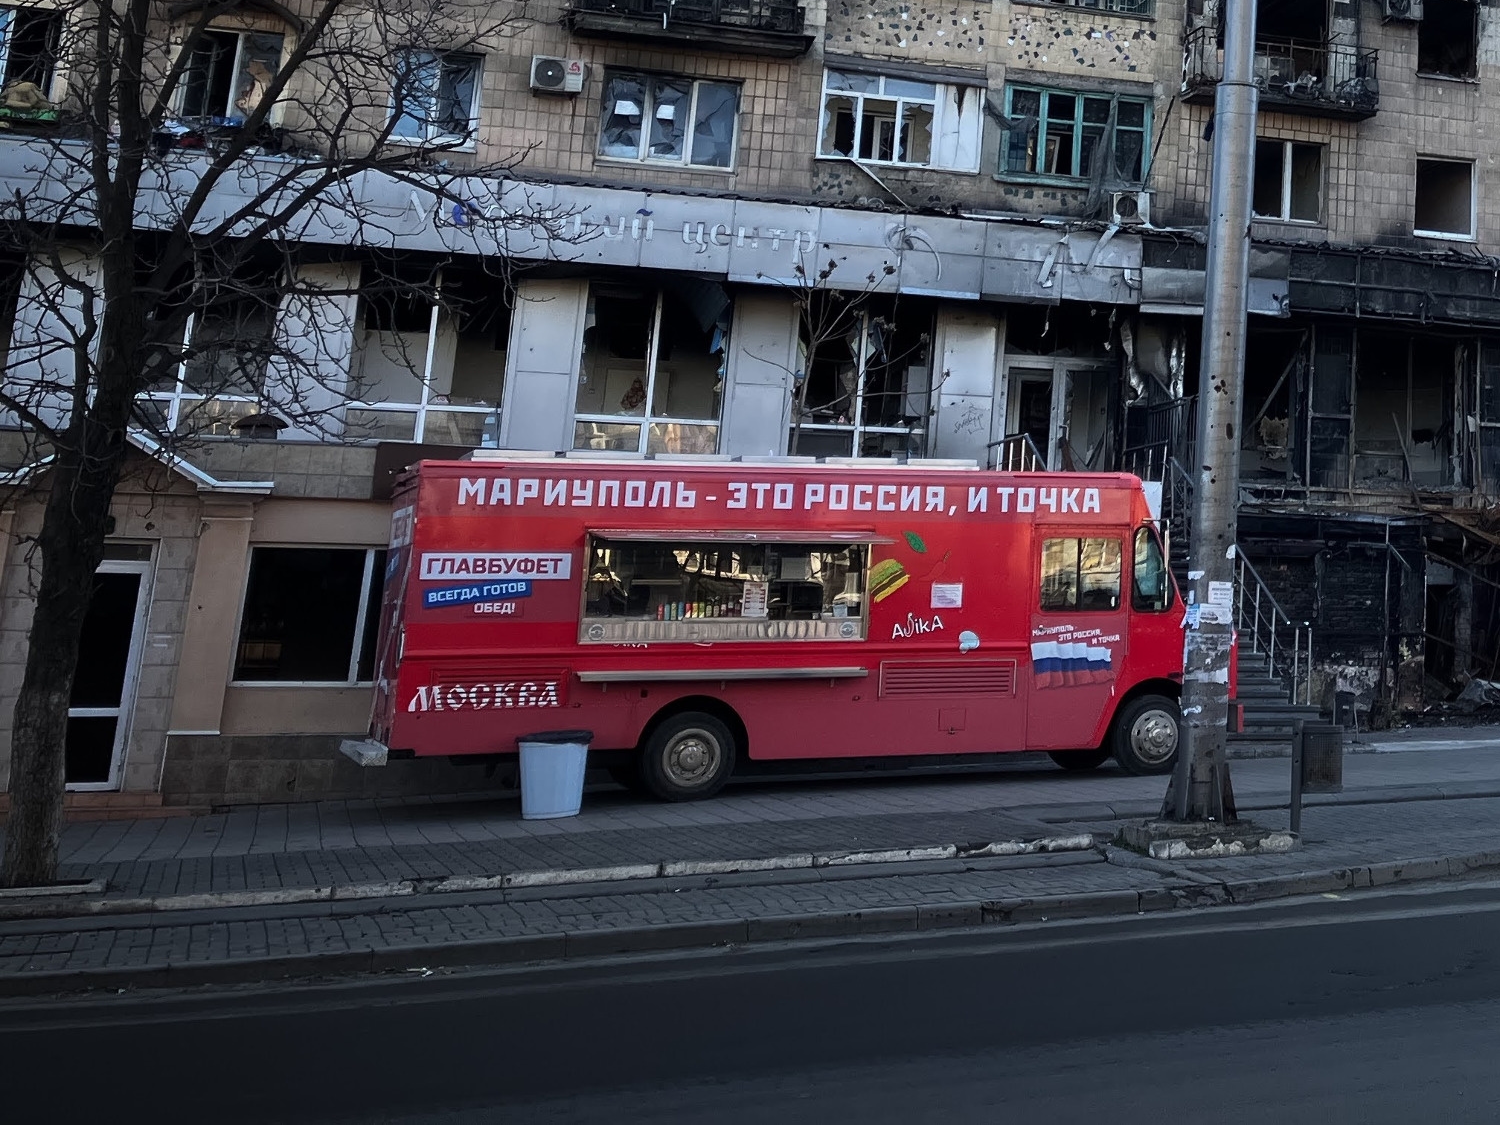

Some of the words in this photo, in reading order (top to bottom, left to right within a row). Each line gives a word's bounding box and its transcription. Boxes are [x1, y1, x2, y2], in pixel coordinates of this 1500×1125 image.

[457, 477, 697, 508] МАРИУПОЛЬ
[726, 482, 794, 510] ЭТО
[804, 484, 957, 516] РОССИЯ,
[967, 486, 988, 512] И
[996, 487, 1101, 513] ТОЧКА
[426, 557, 563, 575] ГЛАВБУФЕТ
[428, 587, 480, 603] ВСЕГДА
[483, 581, 527, 596] ГОТОВ
[474, 602, 516, 614] ОБЕД!
[1058, 633, 1072, 642] ЭТО
[1098, 634, 1120, 644] ТОЧКА
[408, 681, 562, 713] МОСКВА
